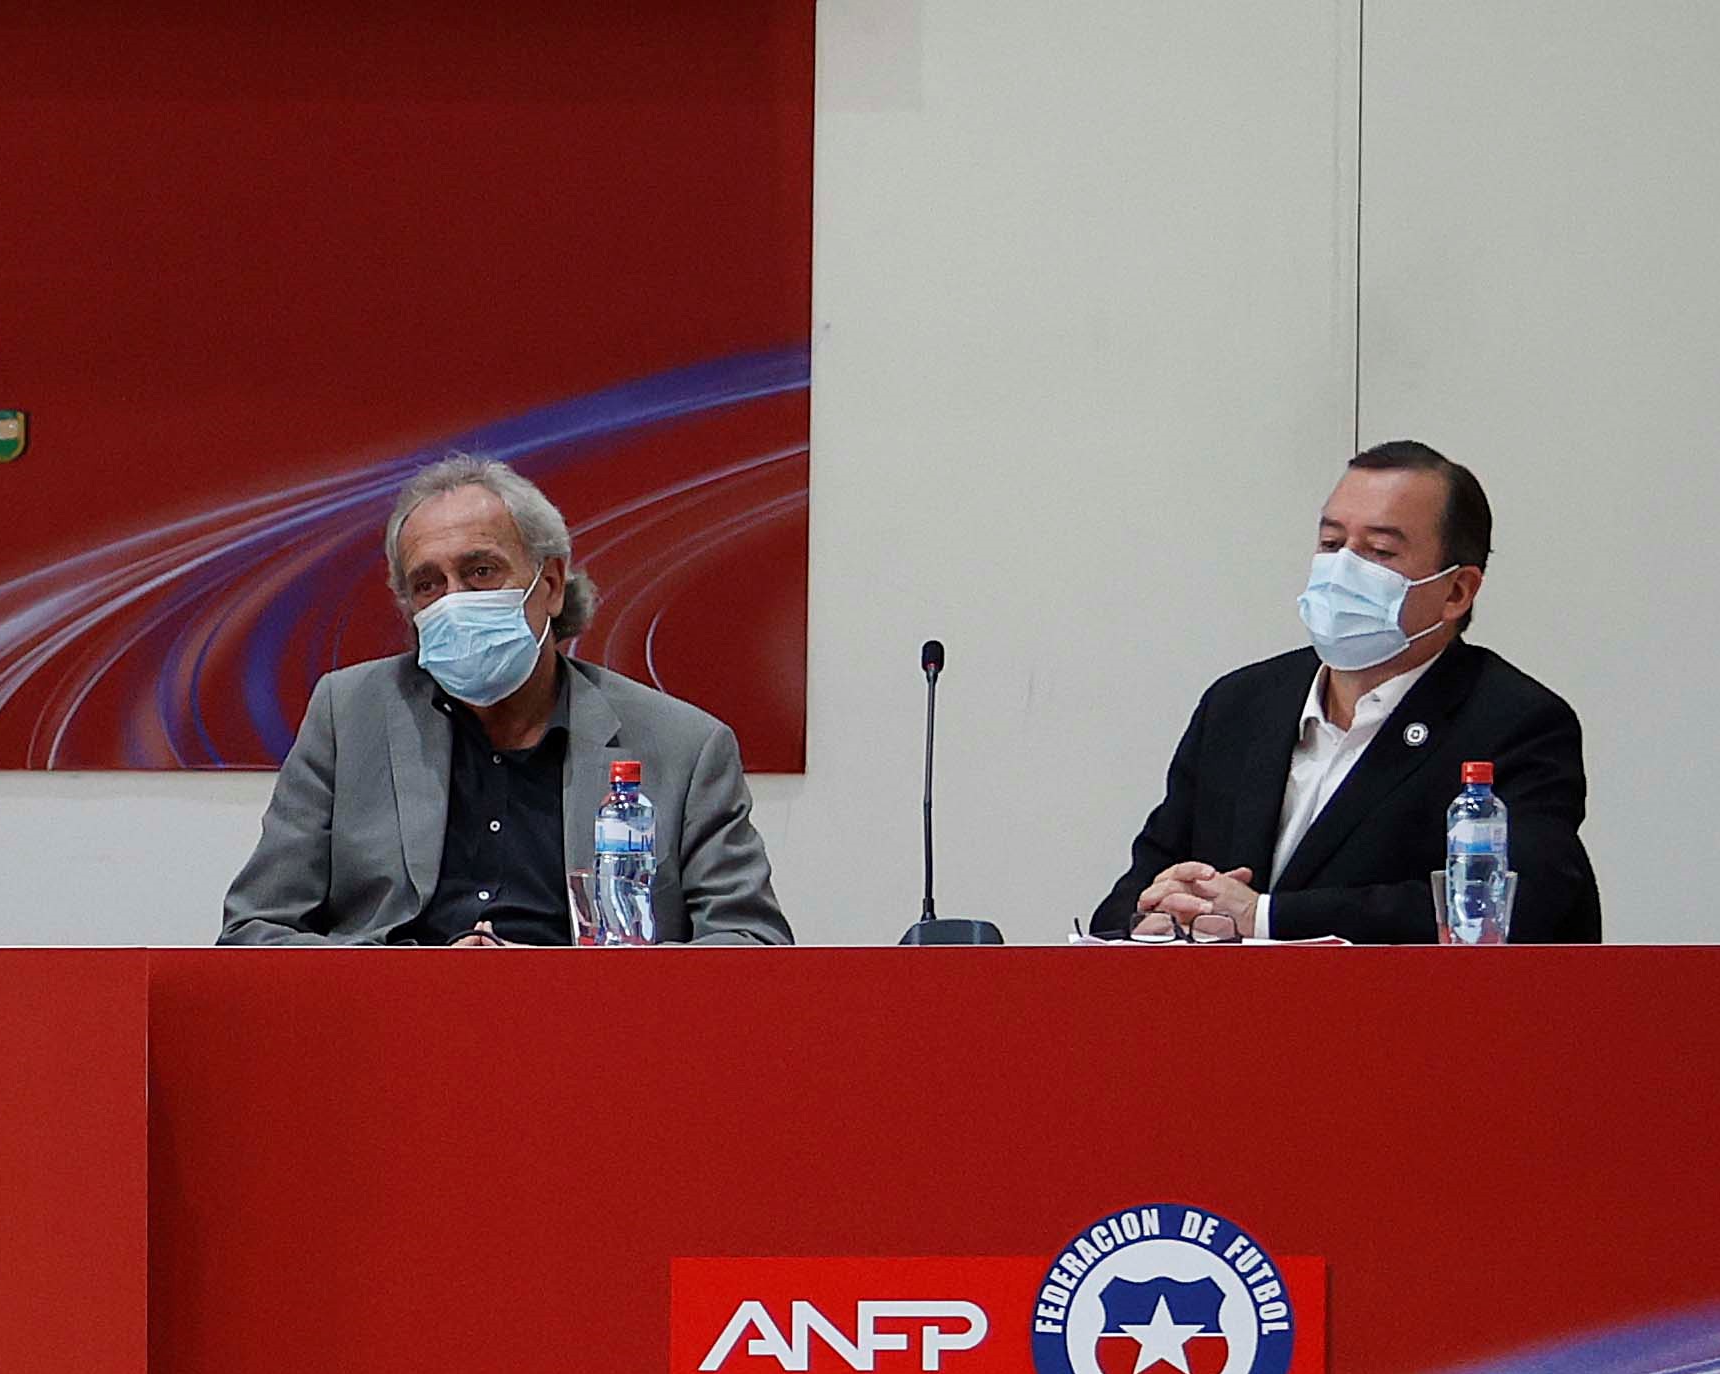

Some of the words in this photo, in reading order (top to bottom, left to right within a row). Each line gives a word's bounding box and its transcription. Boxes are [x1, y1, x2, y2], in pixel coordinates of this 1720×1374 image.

[1035, 1208, 1159, 1335] FEDERACION
[1180, 1210, 1219, 1244] DE
[1222, 1234, 1290, 1336] FUTBOL
[698, 1300, 989, 1371] ANFP
